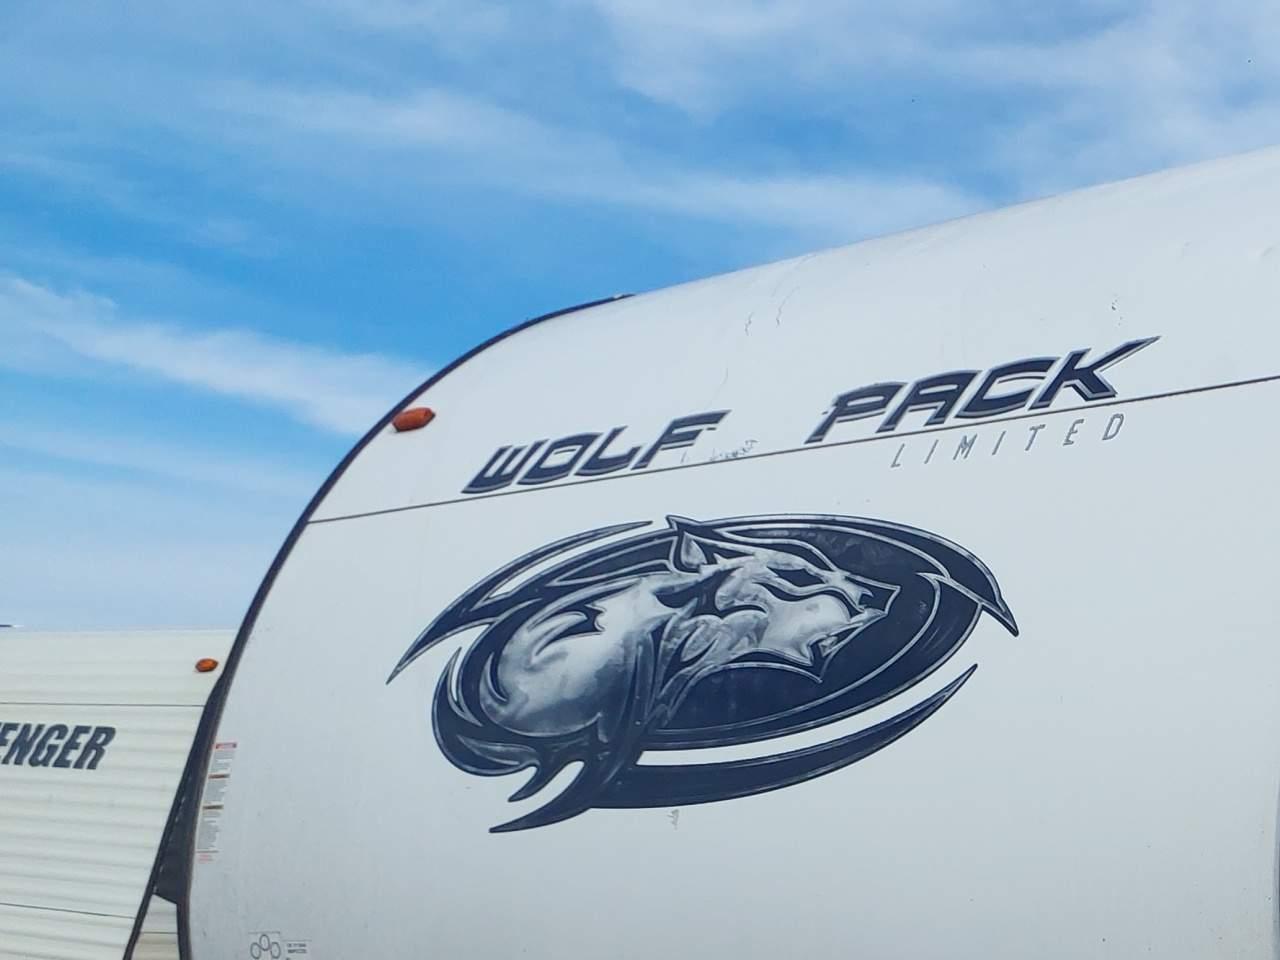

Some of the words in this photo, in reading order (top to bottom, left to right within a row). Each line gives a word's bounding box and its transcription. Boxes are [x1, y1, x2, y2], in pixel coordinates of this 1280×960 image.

[460, 409, 732, 494] WOLF
[804, 335, 1161, 444] PACK
[890, 413, 1125, 468] LIMITED
[0, 722, 117, 770] ENGER
